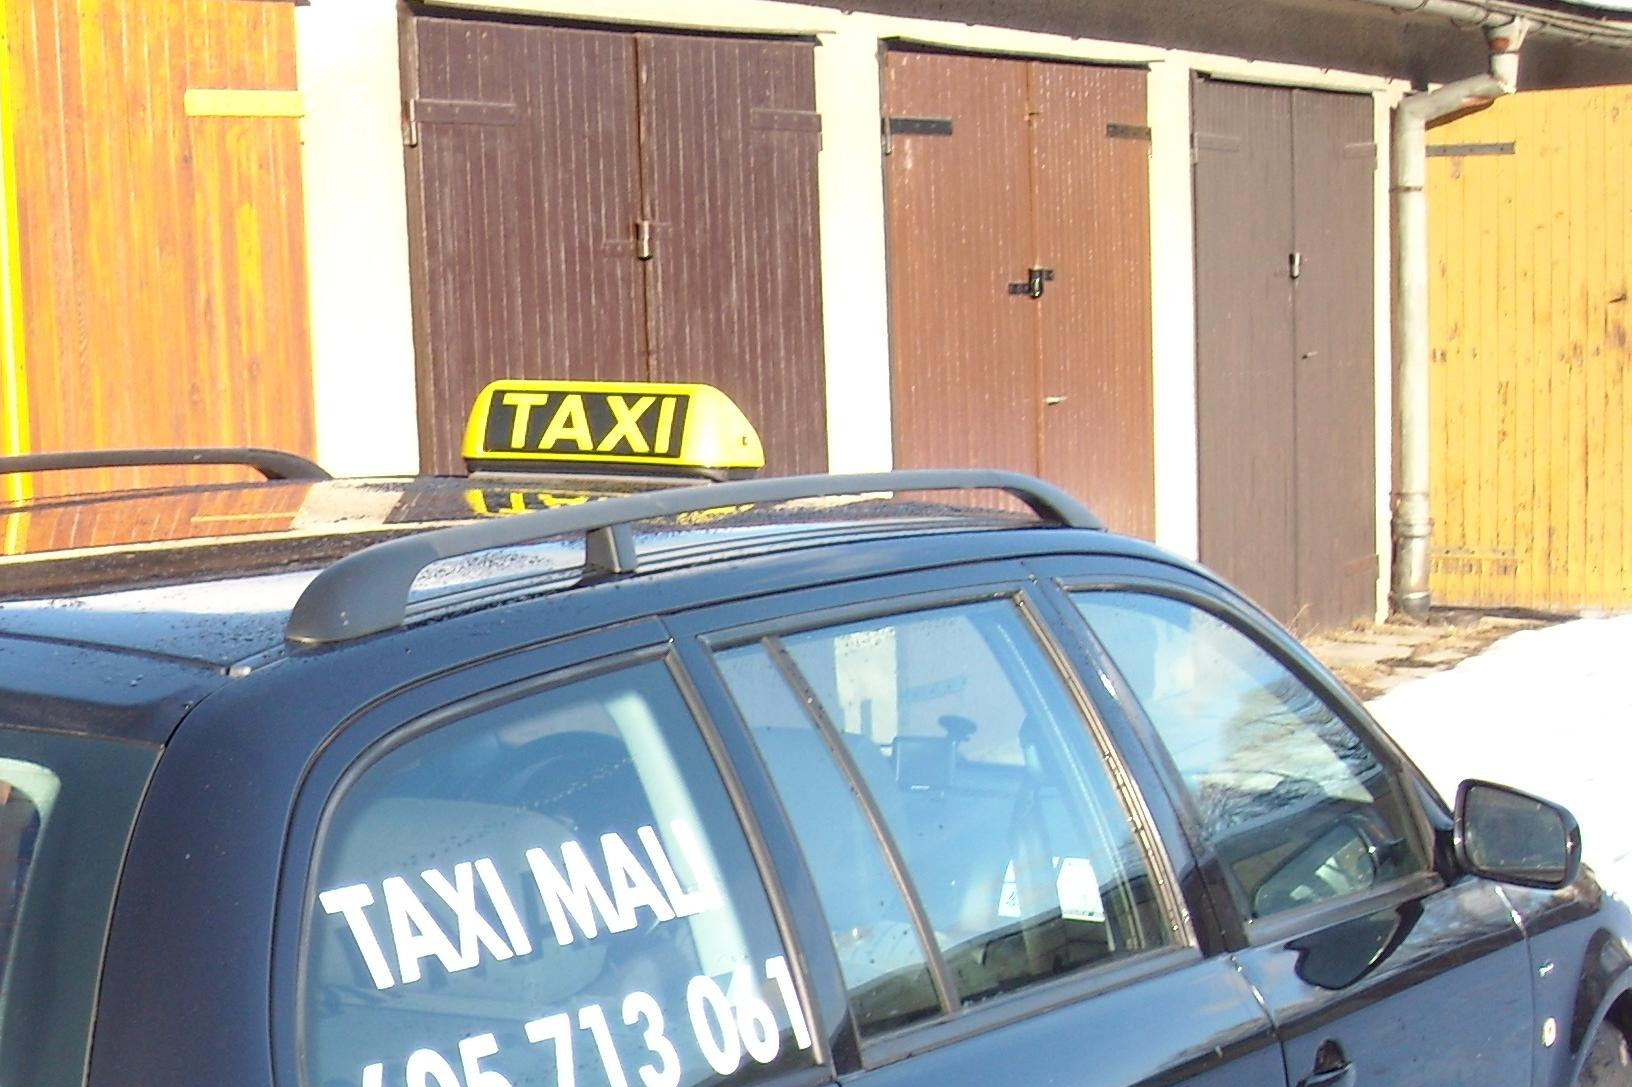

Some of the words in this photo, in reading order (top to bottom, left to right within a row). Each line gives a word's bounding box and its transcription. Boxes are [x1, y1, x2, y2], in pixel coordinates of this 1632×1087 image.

[503, 393, 677, 453] TAXI
[319, 858, 532, 990] TAXI
[686, 955, 812, 1077] 061
